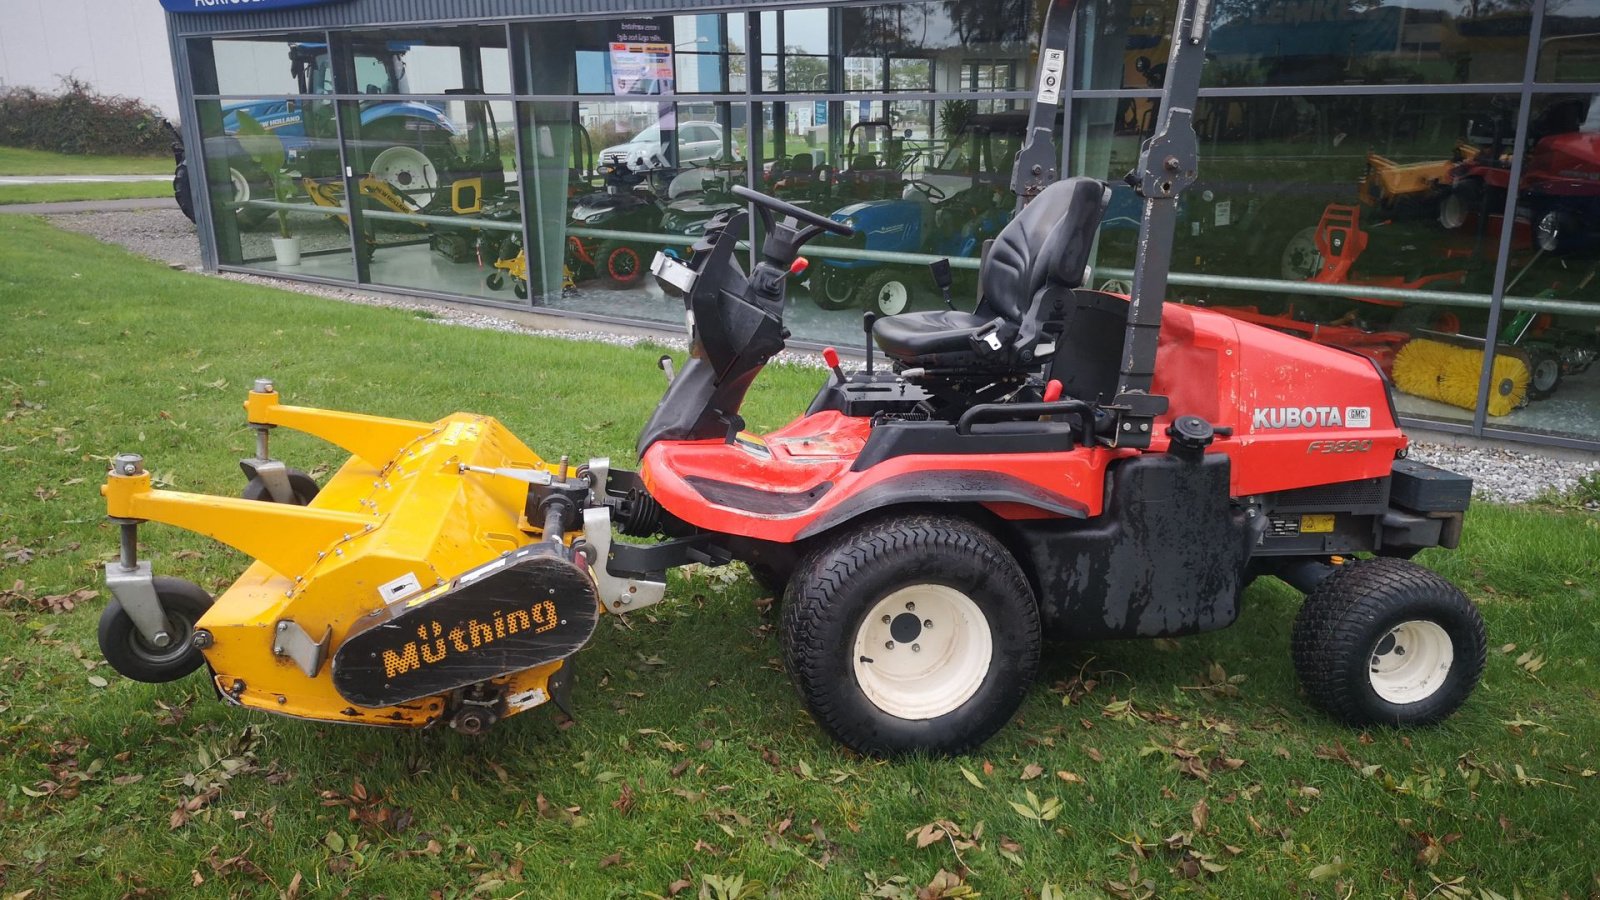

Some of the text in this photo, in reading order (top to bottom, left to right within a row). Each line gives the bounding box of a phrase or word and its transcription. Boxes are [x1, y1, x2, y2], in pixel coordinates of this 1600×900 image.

[269, 115, 301, 126] HOLLAND
[1253, 406, 1343, 429] KUBOTA
[1350, 408, 1366, 419] GMC
[382, 600, 558, 678] Müthing
